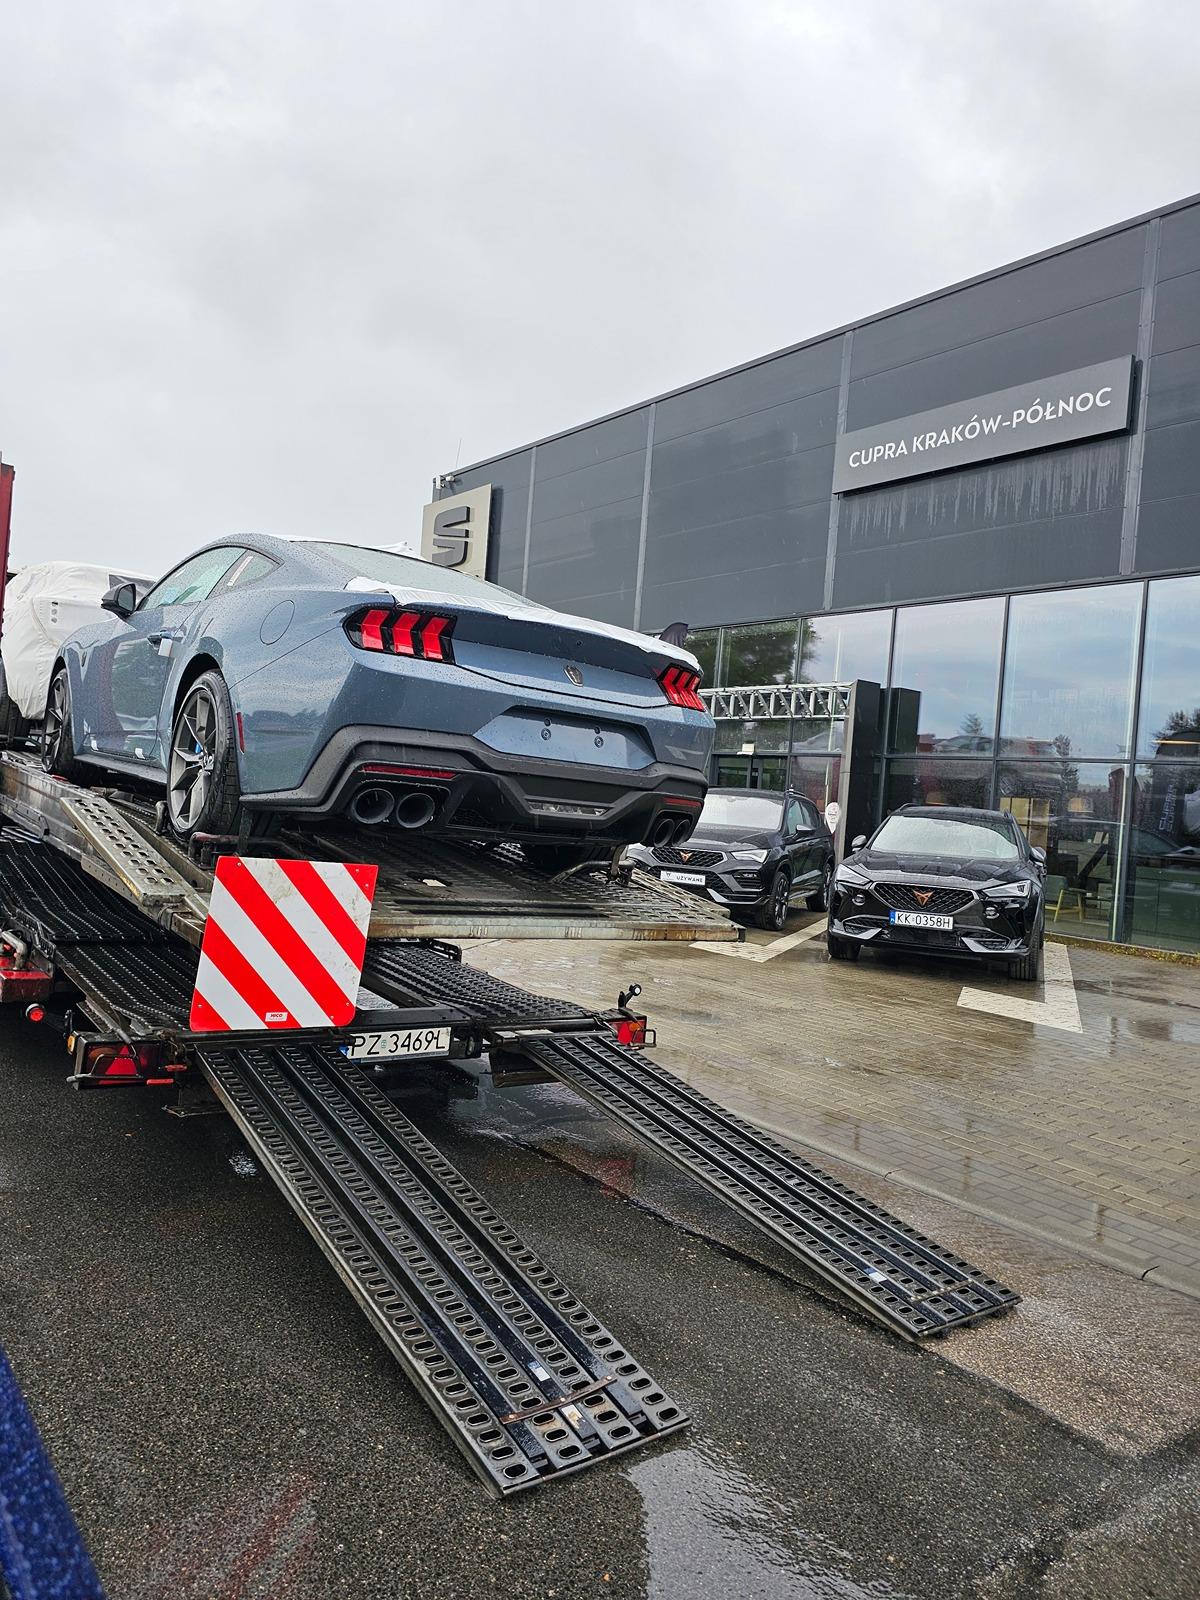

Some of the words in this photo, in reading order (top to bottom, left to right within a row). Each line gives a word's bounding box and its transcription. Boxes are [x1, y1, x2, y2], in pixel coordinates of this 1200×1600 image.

[849, 439, 908, 468] CUPRA
[912, 387, 1112, 453] KRAKÓW-PÓŁNOC
[897, 913, 911, 924] KK
[915, 914, 950, 928] 0358H
[351, 1034, 381, 1056] PZ
